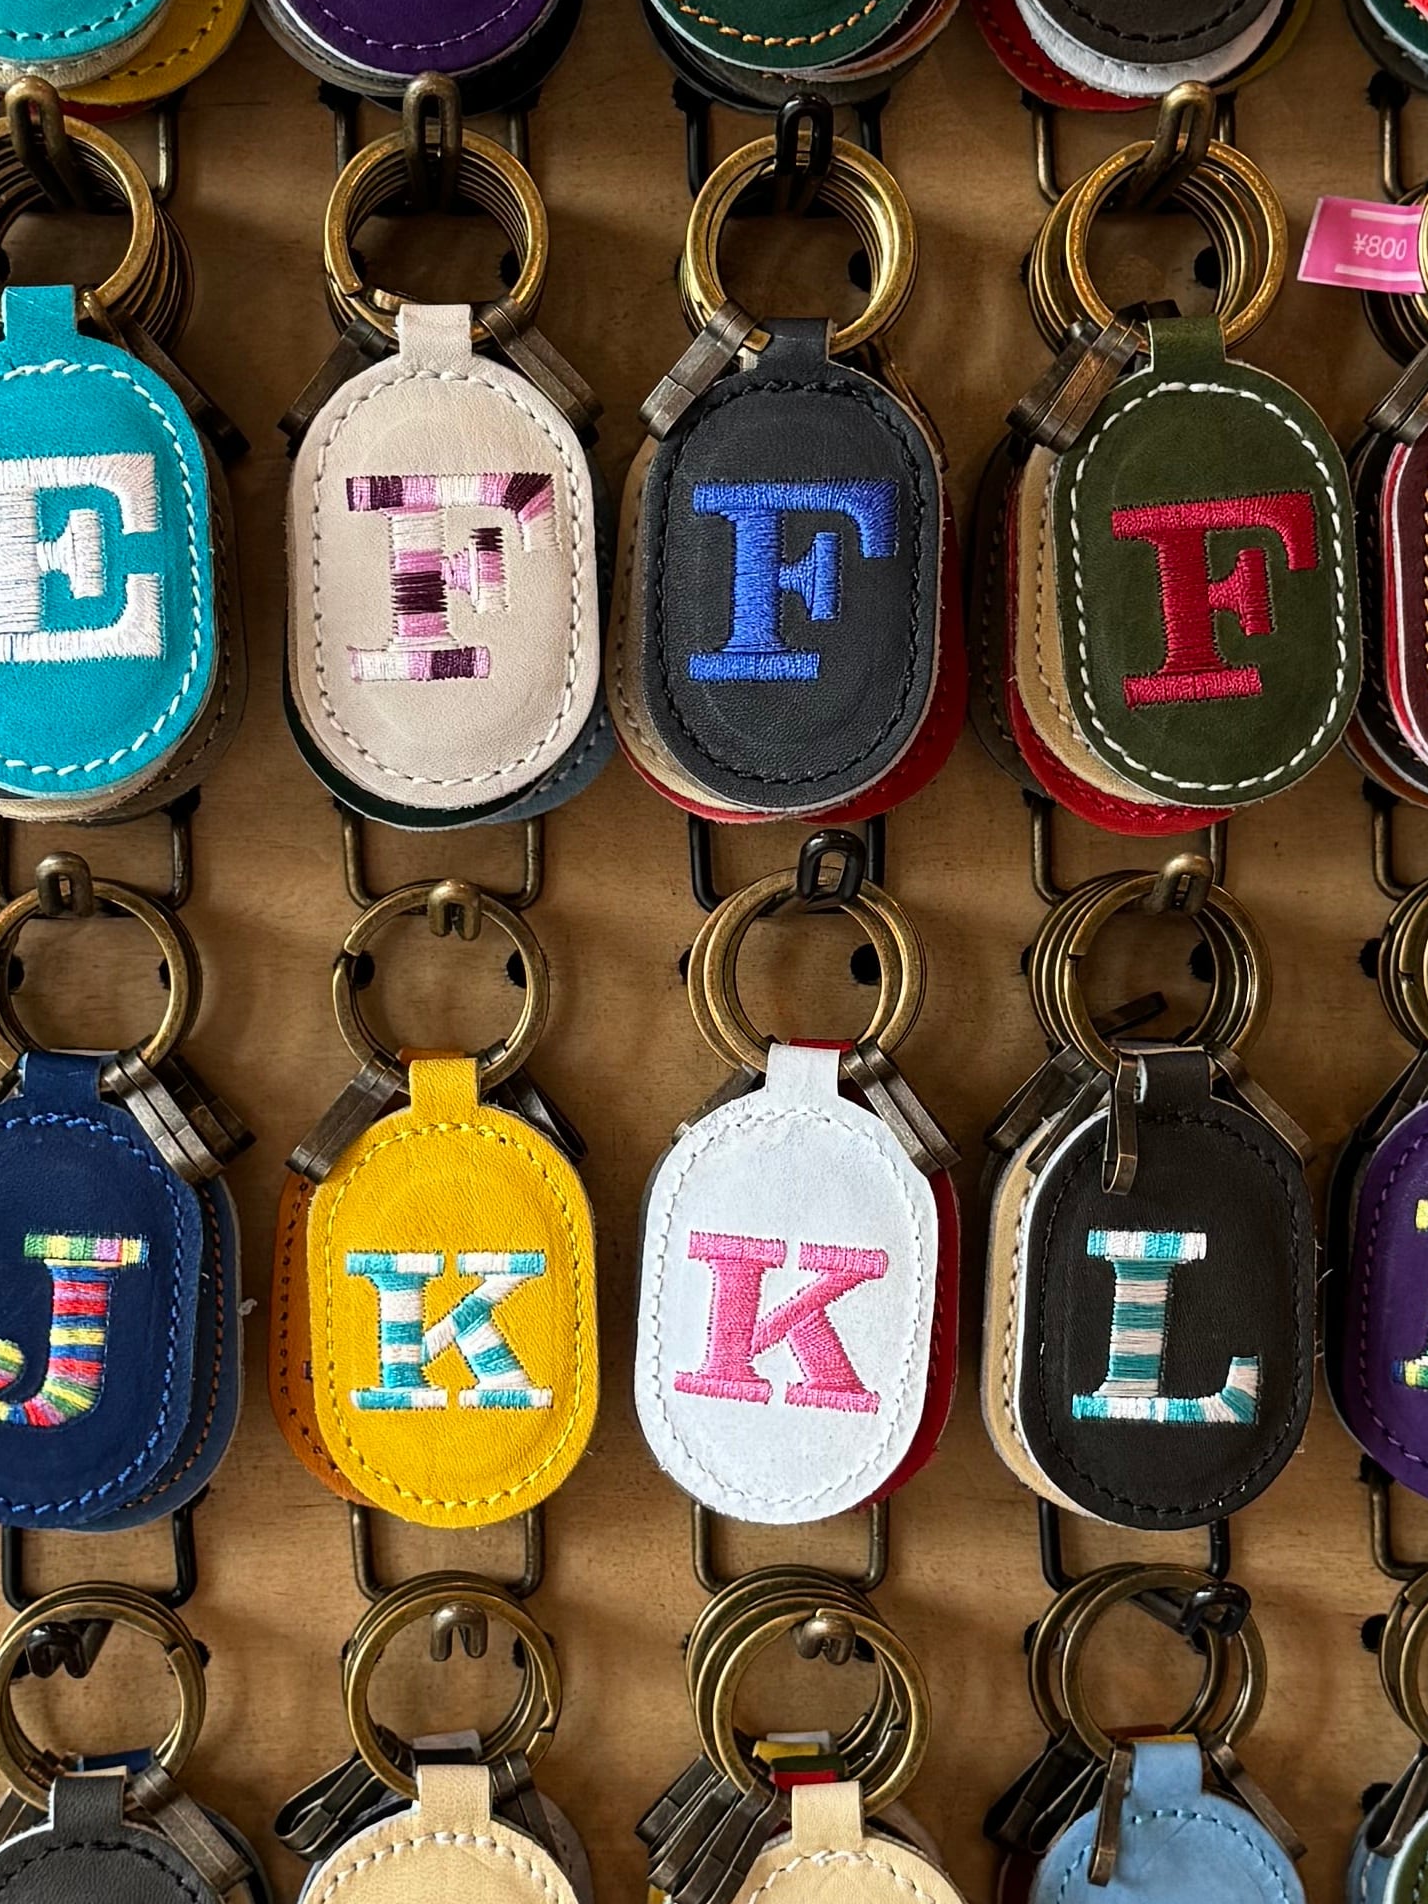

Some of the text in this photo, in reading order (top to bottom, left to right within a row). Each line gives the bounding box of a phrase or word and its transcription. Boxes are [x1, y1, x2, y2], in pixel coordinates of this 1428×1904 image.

[1353, 232, 1407, 261] ¥800
[345, 471, 558, 684] F
[686, 479, 902, 684] F
[1110, 490, 1320, 711] F
[344, 1250, 555, 1413] K
[673, 1229, 891, 1415] K
[1071, 1228, 1262, 1426] L
